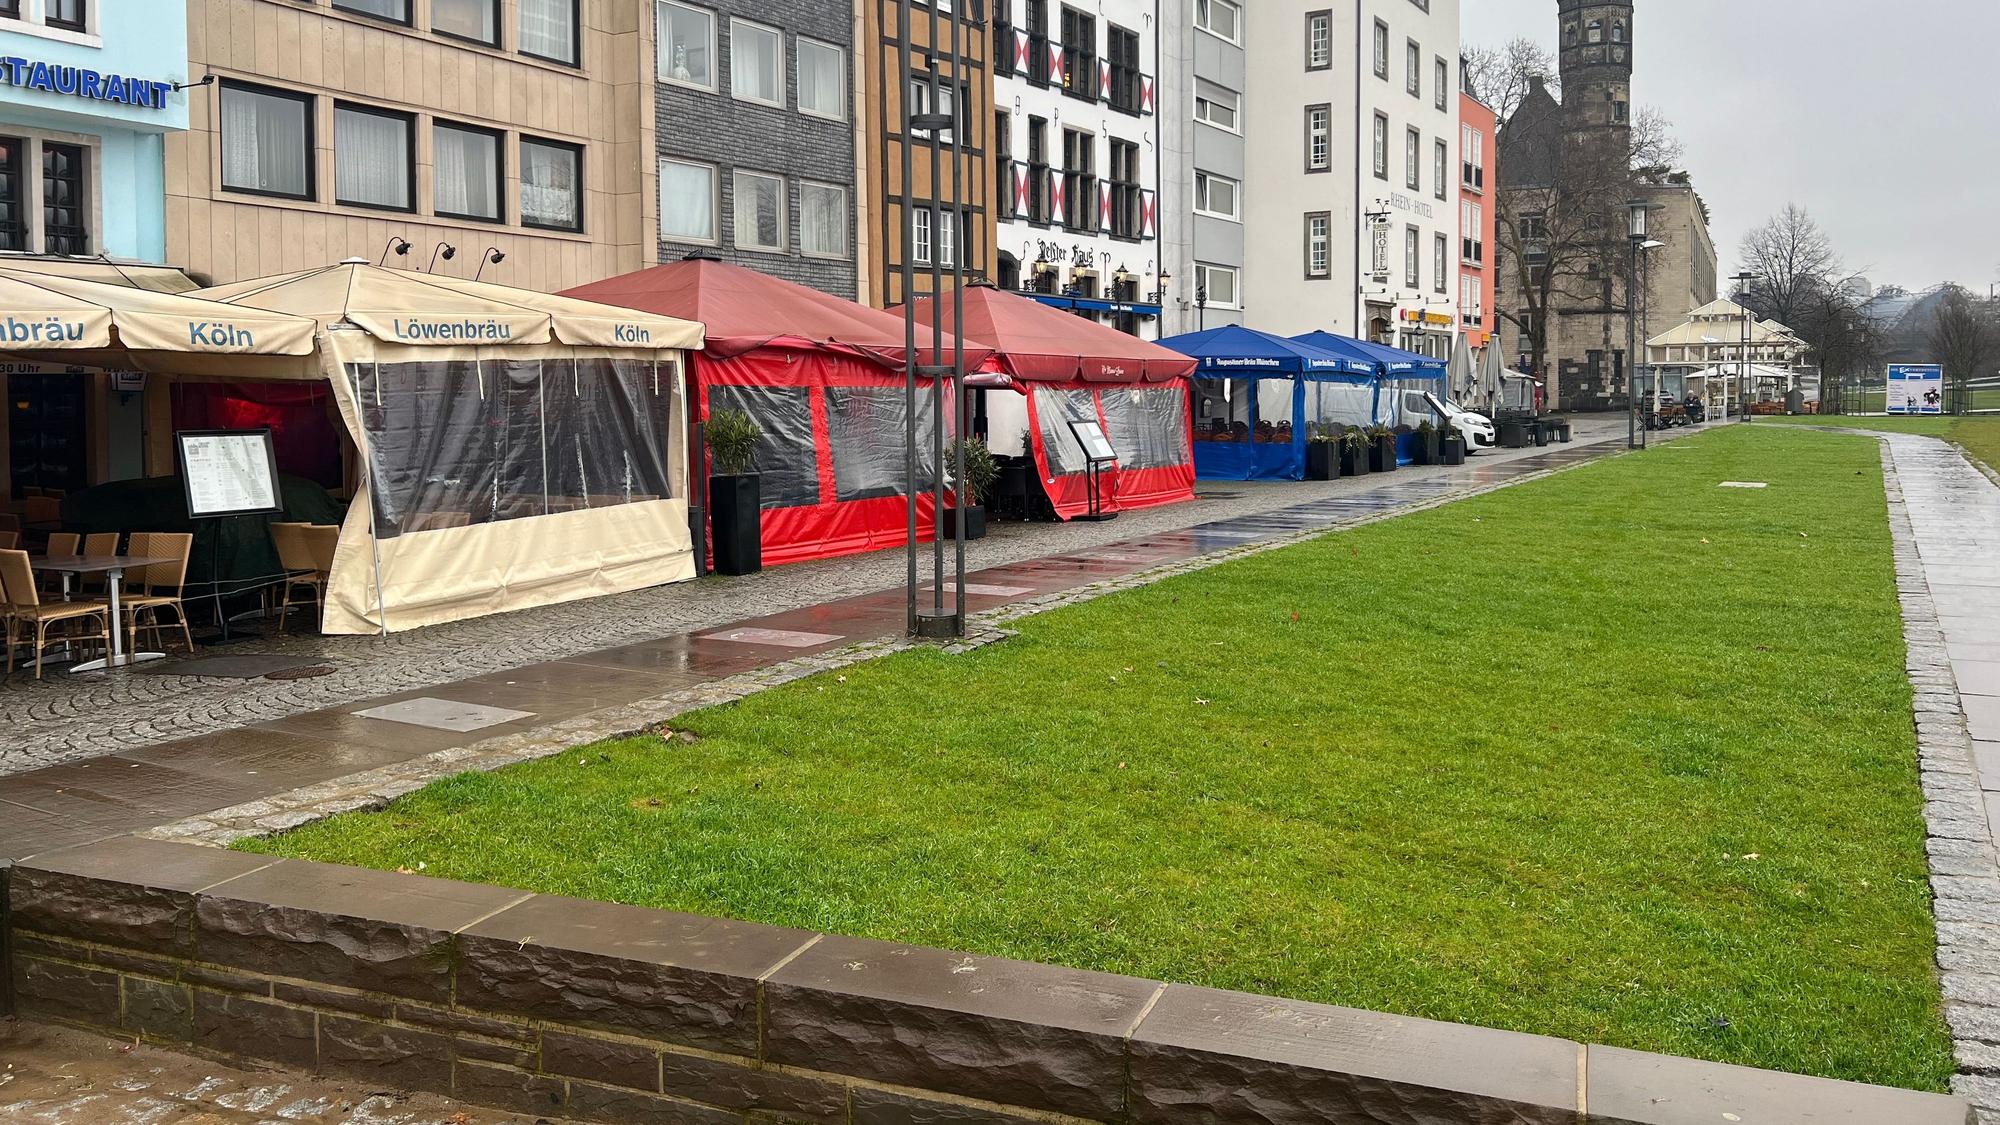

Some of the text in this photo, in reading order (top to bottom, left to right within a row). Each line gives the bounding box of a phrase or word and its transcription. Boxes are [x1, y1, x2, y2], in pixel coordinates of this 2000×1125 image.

[0, 56, 171, 109] TAURANT
[1378, 231, 1386, 268] HOTEL
[189, 322, 253, 346] Köln
[394, 319, 511, 339] Löwenbräu
[615, 324, 649, 342] Köln
[19, 364, 40, 373] Uhr
